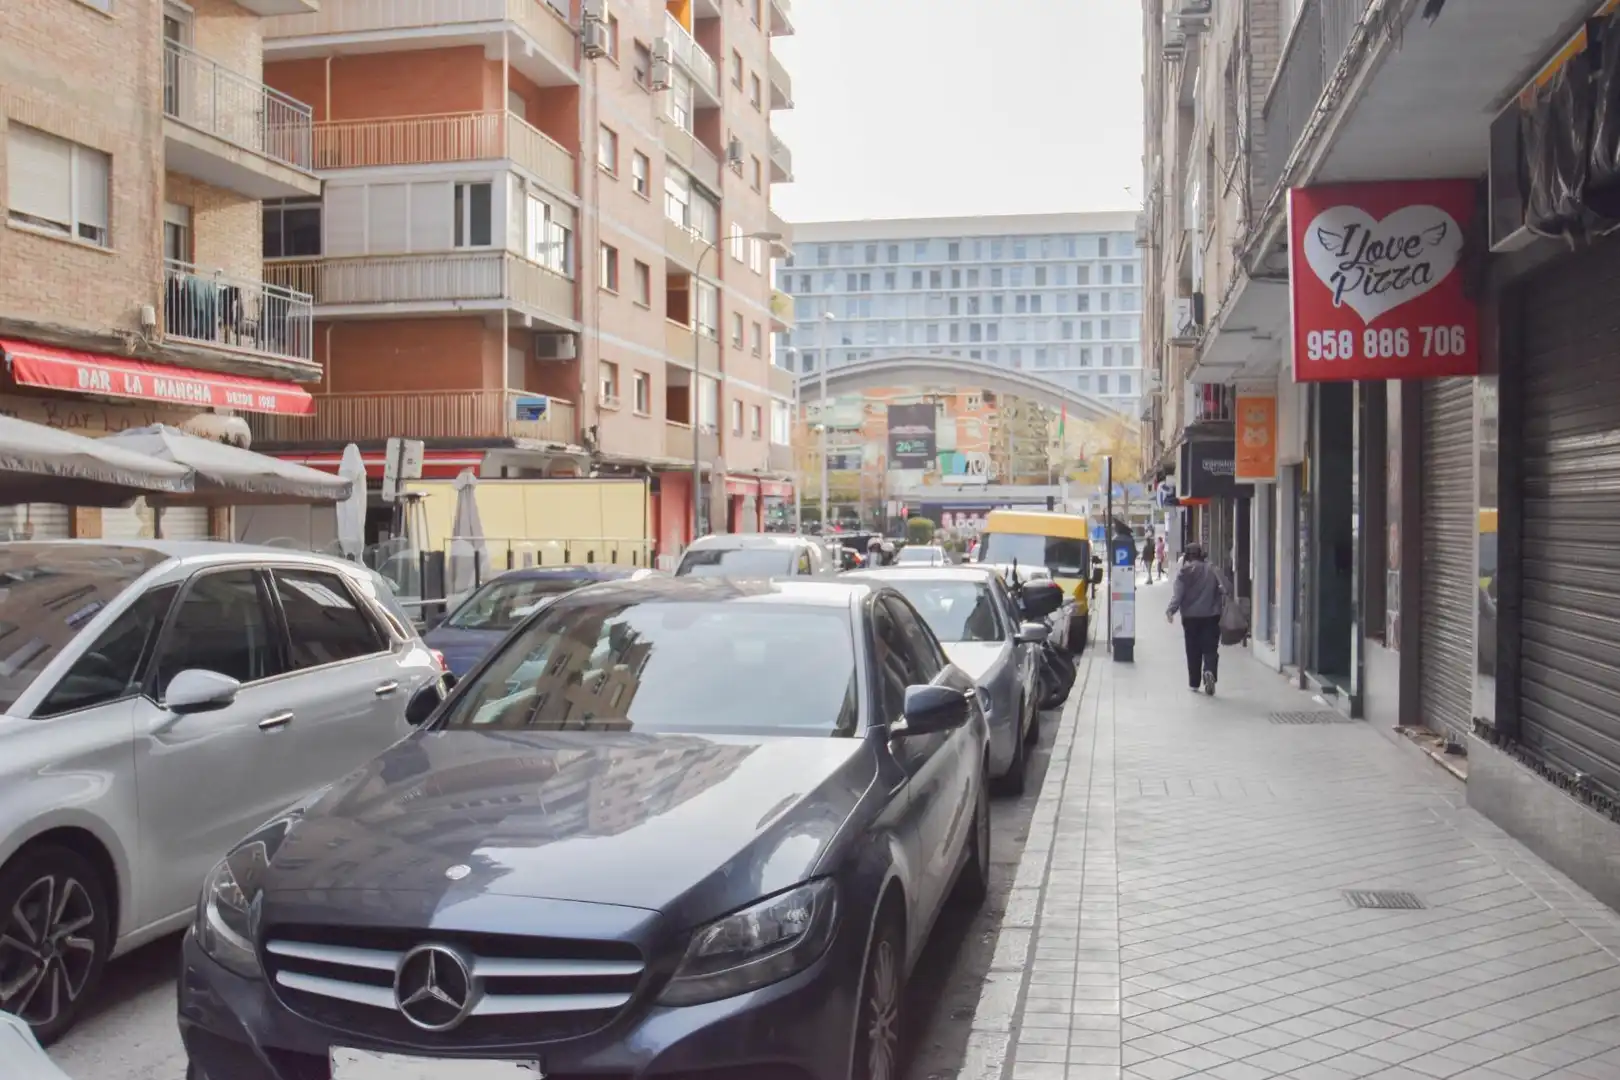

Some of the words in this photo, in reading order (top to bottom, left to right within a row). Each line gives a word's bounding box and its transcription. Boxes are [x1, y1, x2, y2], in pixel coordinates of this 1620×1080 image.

[1335, 223, 1361, 258] I
[1339, 228, 1425, 271] Love
[1330, 261, 1434, 305] Pizza
[1307, 329, 1354, 361] 958
[1363, 326, 1410, 359] 886
[1418, 324, 1467, 358] 706
[77, 366, 112, 393] BAR
[123, 372, 143, 395] LA
[153, 377, 213, 403] MANCHA
[1115, 547, 1129, 565] P
